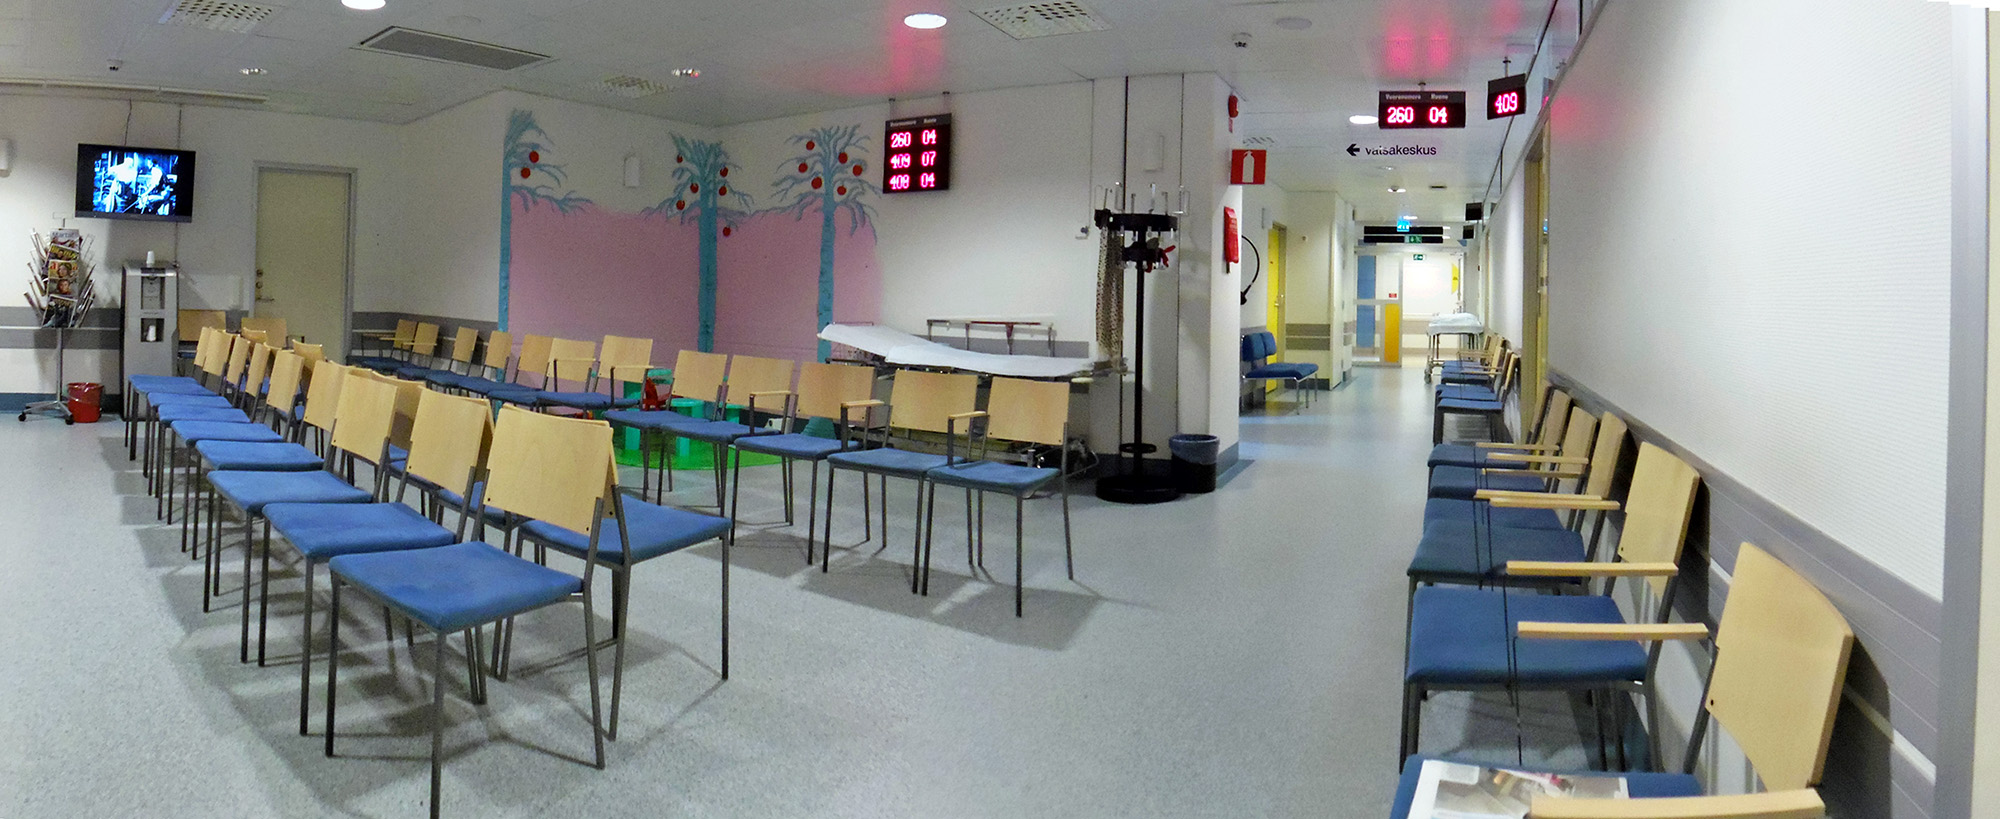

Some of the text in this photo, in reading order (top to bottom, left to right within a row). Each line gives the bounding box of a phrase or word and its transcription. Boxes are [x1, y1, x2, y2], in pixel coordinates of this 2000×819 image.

[1494, 92, 1518, 114] 409
[1387, 106, 1447, 123] 260 04
[890, 129, 937, 148] 260 04
[889, 150, 937, 169] 409 07
[889, 172, 935, 190] 408 04
